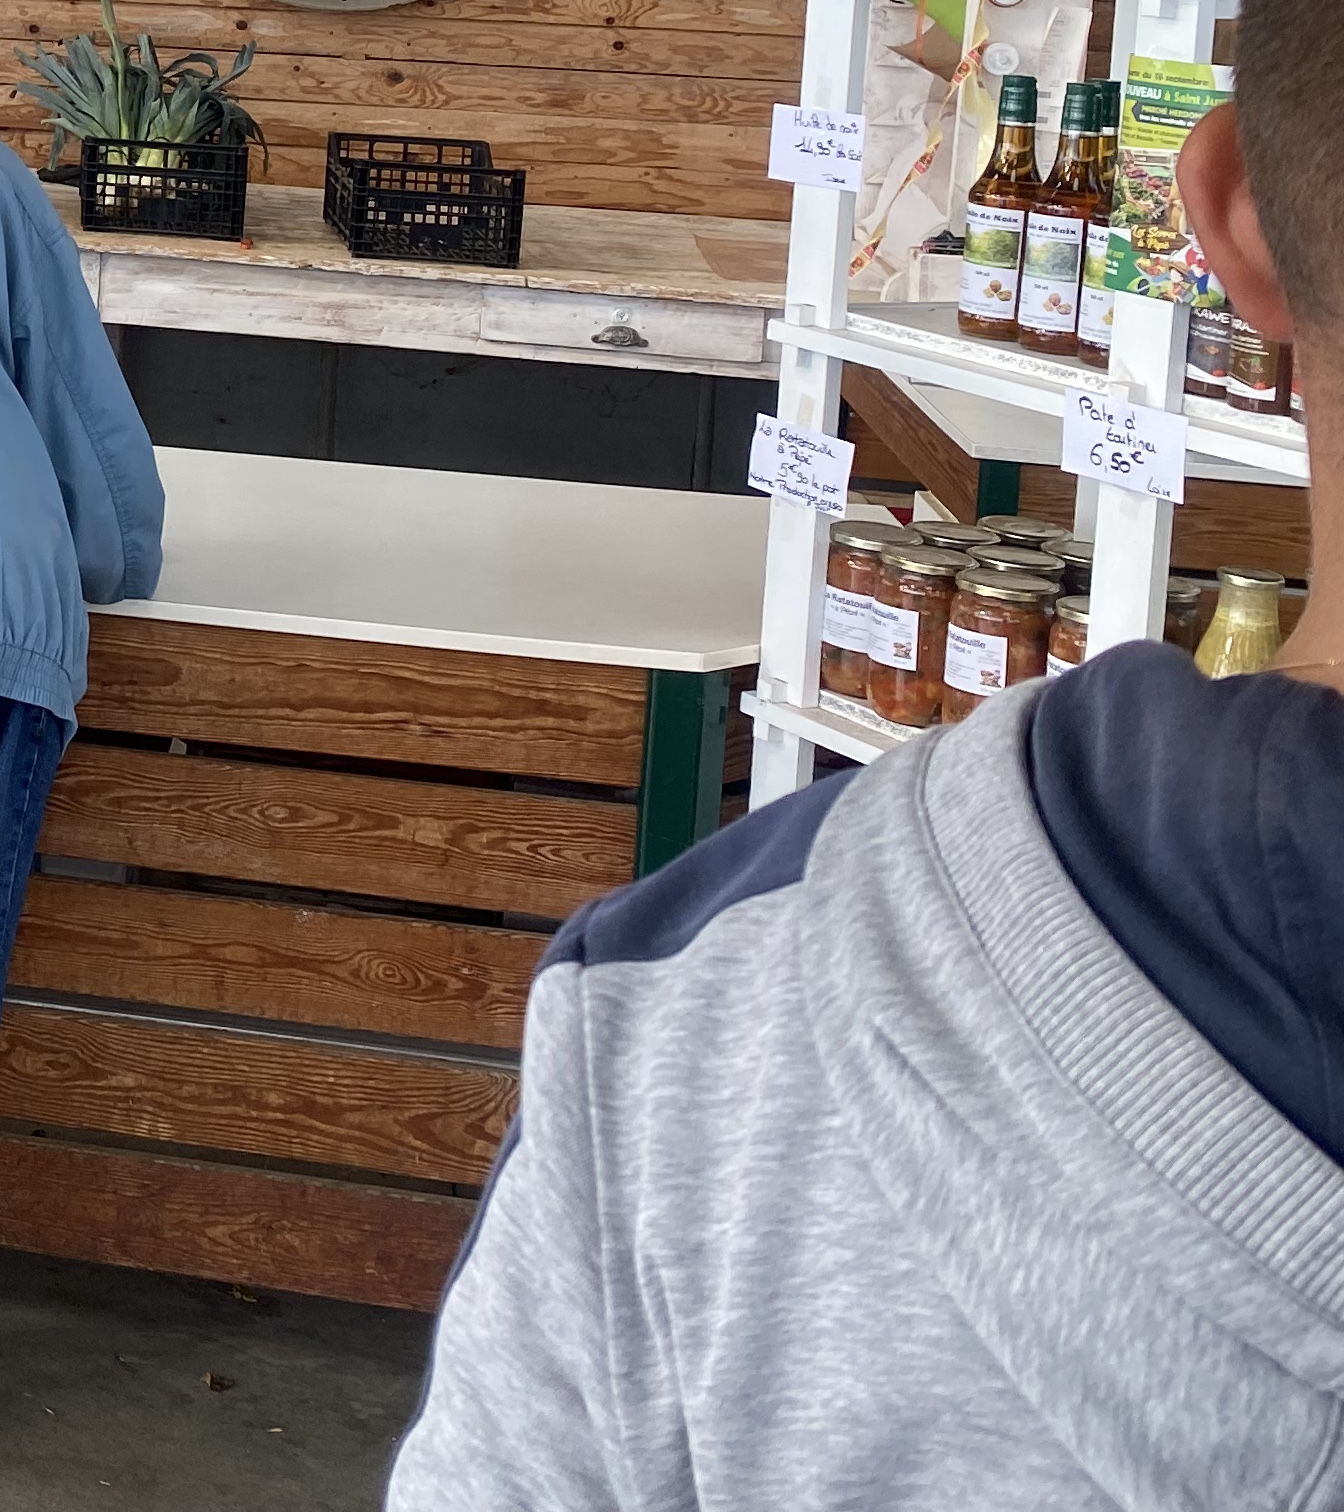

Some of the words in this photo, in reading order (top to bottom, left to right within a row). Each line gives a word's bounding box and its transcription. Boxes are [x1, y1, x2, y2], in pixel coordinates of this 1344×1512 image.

[1174, 91, 1201, 105] Saint
[994, 214, 1019, 223] Noix
[1051, 226, 1077, 235] Noix
